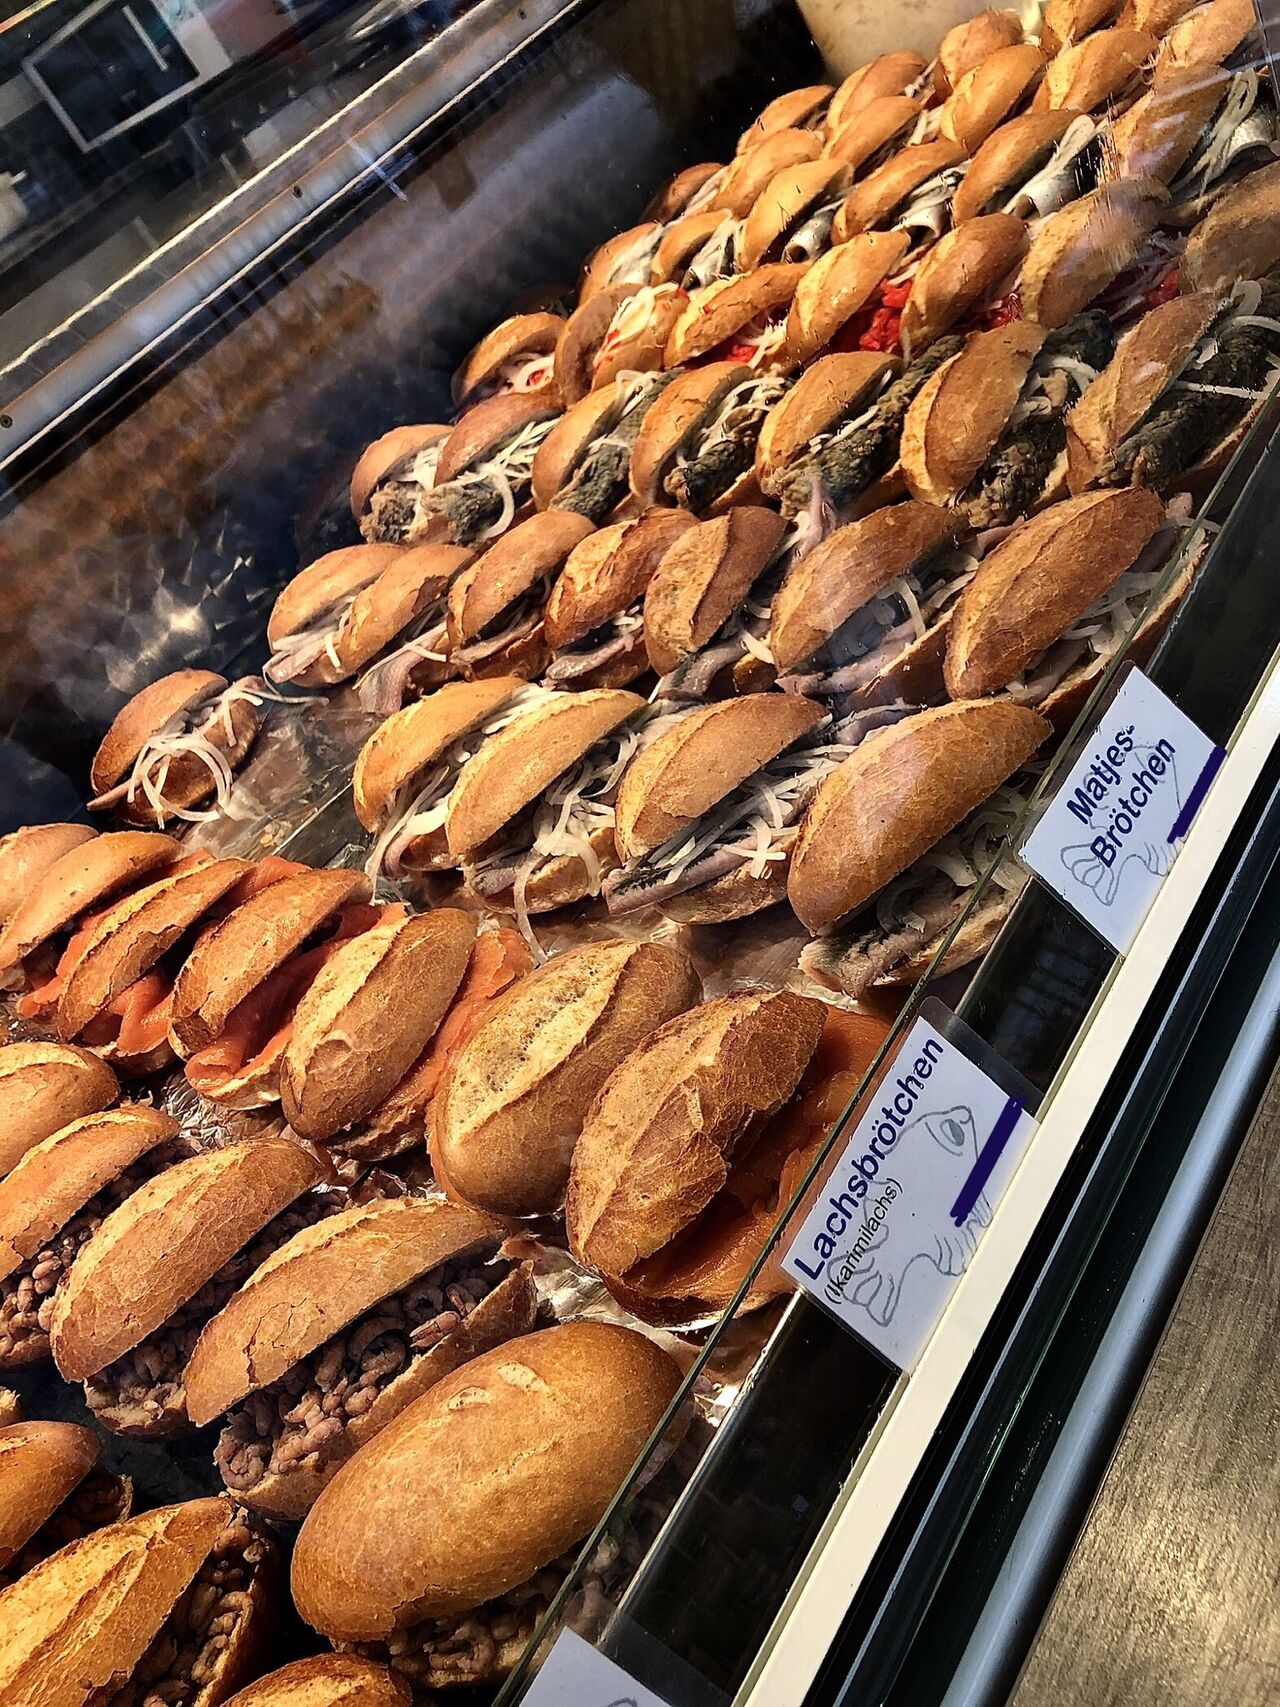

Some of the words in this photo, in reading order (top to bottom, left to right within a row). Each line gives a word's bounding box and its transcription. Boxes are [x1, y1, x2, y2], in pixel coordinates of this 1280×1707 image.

[1090, 738, 1176, 868] Brötchen
[794, 1038, 944, 1280] Lachsbrötchen
[823, 1177, 903, 1305] (Ikarimilachs)
